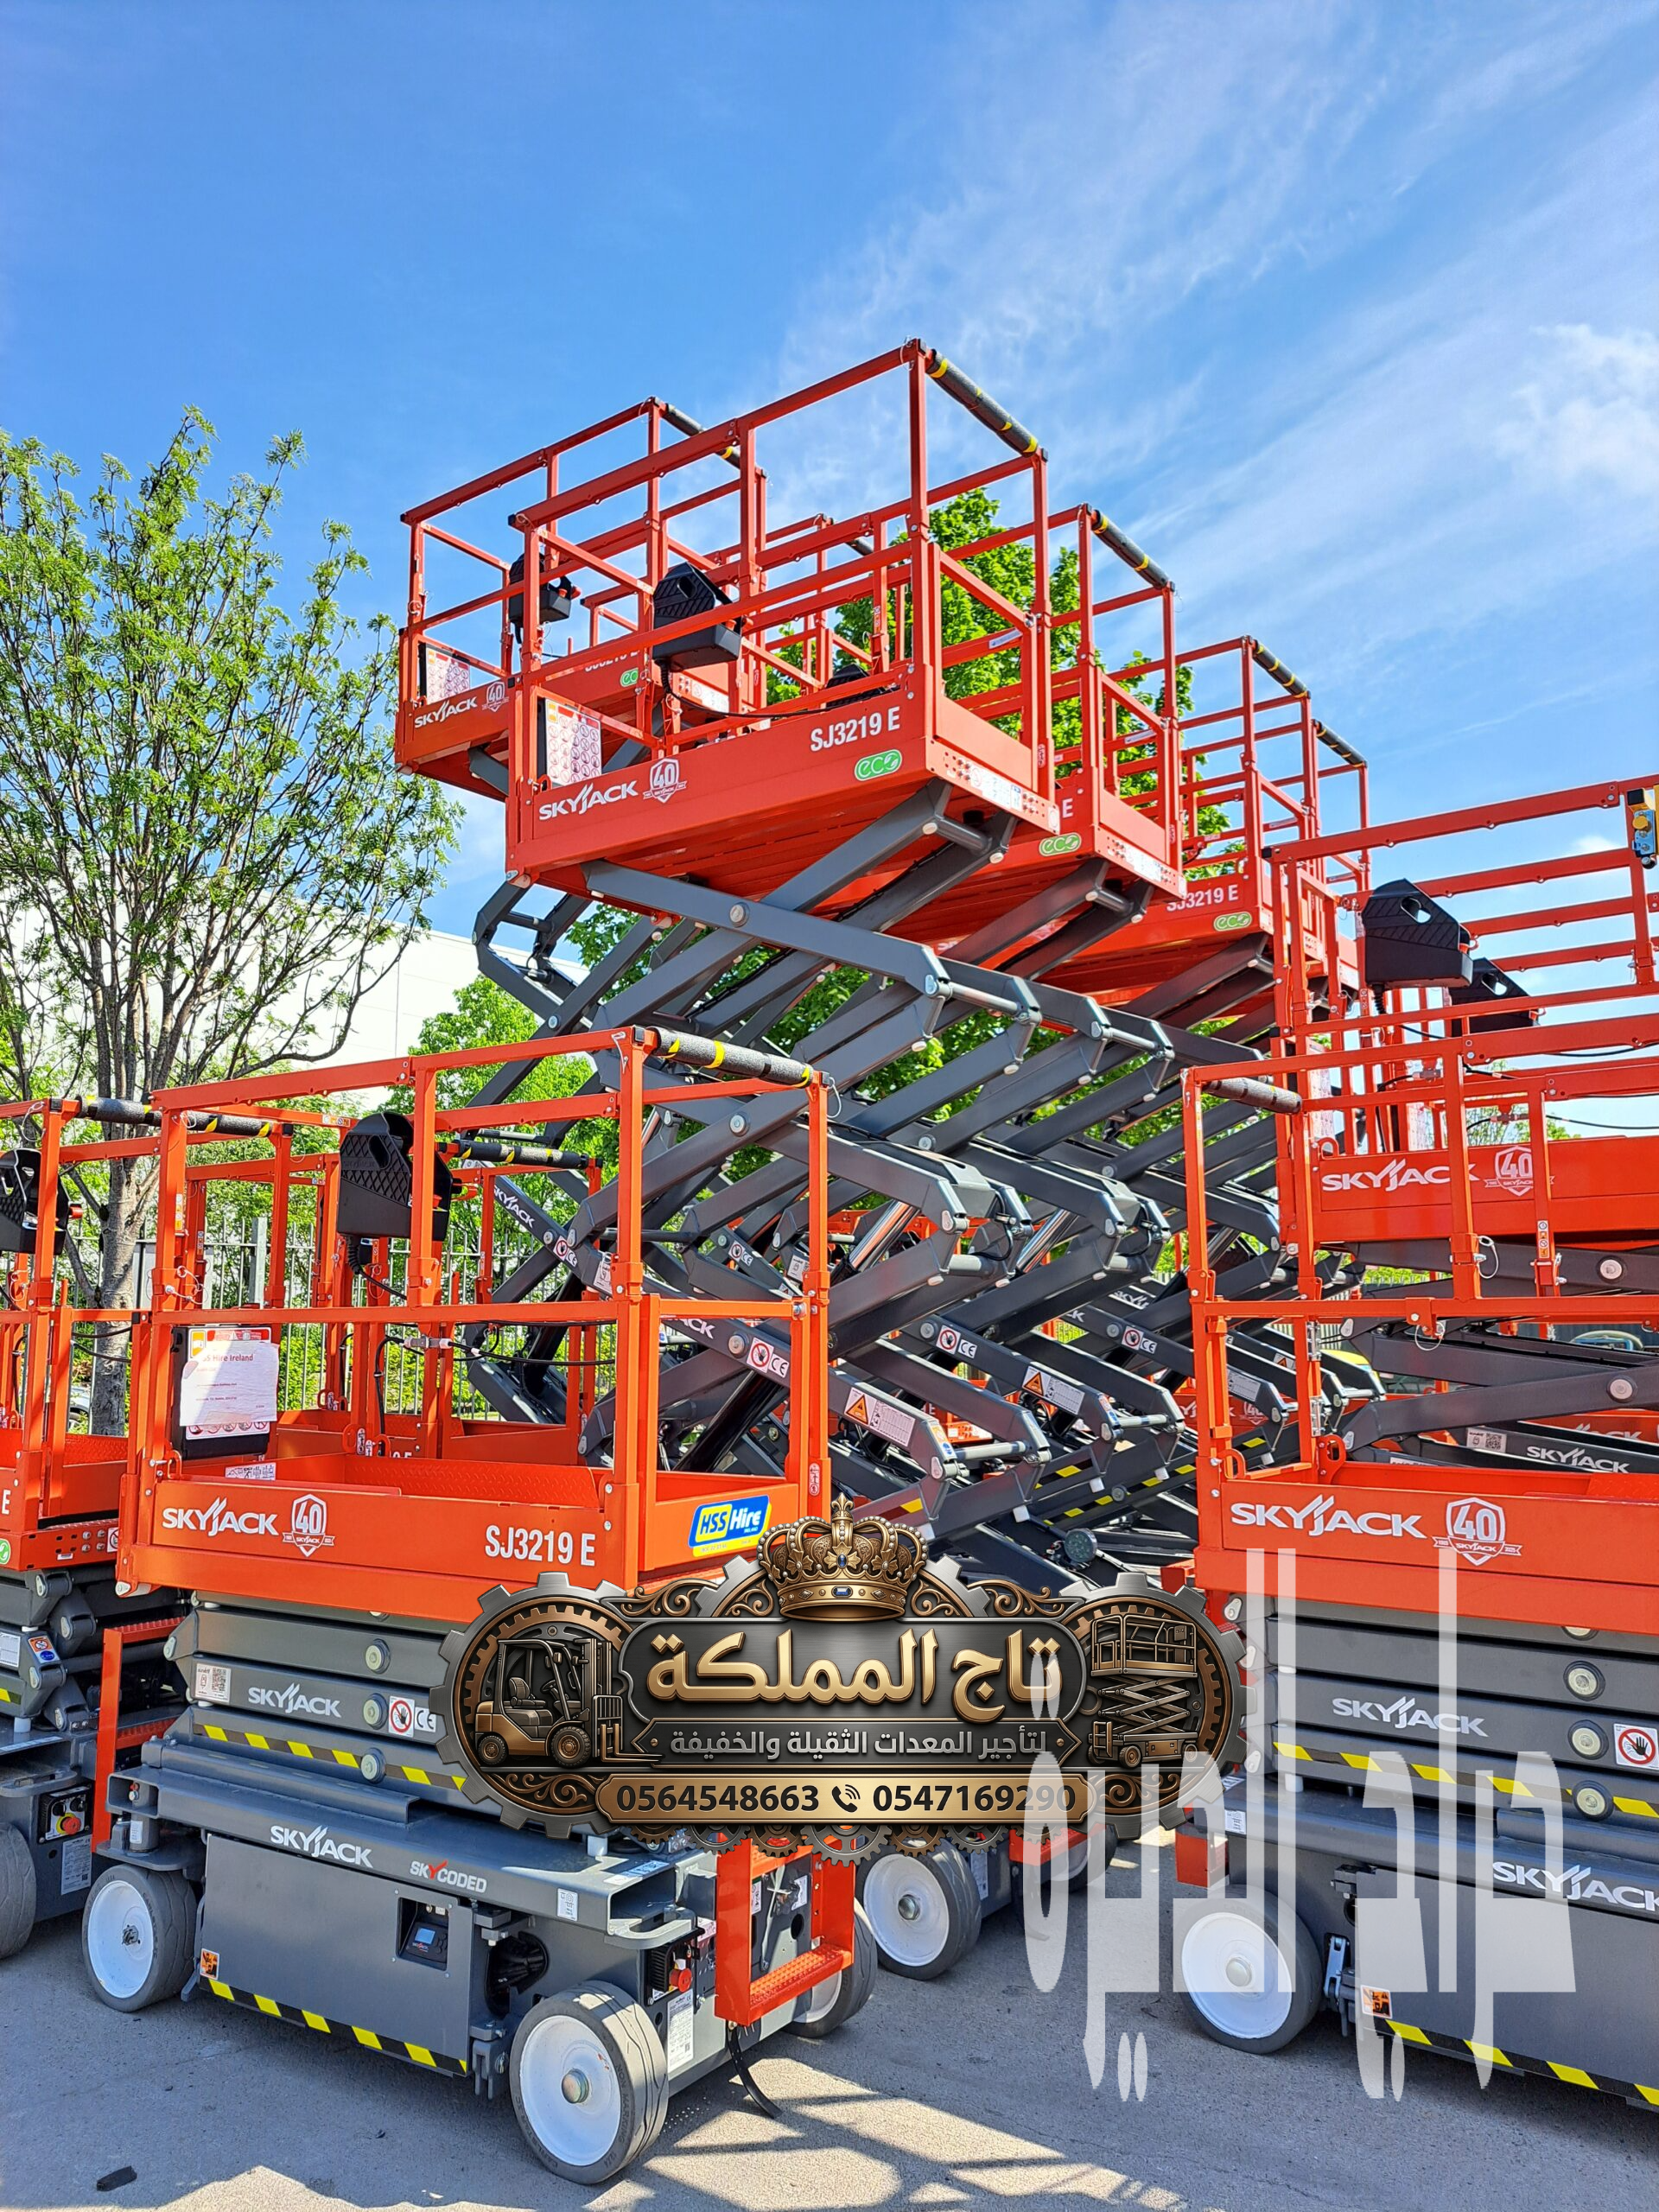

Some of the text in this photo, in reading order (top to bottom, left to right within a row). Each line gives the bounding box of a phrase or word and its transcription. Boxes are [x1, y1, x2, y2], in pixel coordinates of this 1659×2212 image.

[488, 685, 502, 702] 40
[415, 696, 477, 728] SKYJACK
[810, 706, 900, 752] SJ3219 E
[653, 763, 675, 789] 40
[858, 752, 899, 778] eco
[538, 780, 639, 820] SKYJACK
[1042, 835, 1079, 854] eco
[1228, 884, 1239, 901] E
[1527, 1447, 1630, 1474] SKYJACK
[2, 1489, 11, 1515] E
[162, 1497, 279, 1536] SKYJACK
[296, 1501, 322, 1535] 40
[1230, 1494, 1427, 1539] SKYJACK
[700, 1508, 762, 1535] HSS Hire
[1453, 1504, 1497, 1541] 40
[485, 1525, 595, 1567] SJ3219 E
[1456, 1542, 1497, 1552] SKYJACK
[248, 1682, 341, 1718] SKYJACK
[1332, 1696, 1489, 1738] SKYJACK
[270, 1825, 373, 1868] SKYJACK
[410, 1859, 487, 1893] SKYCODED
